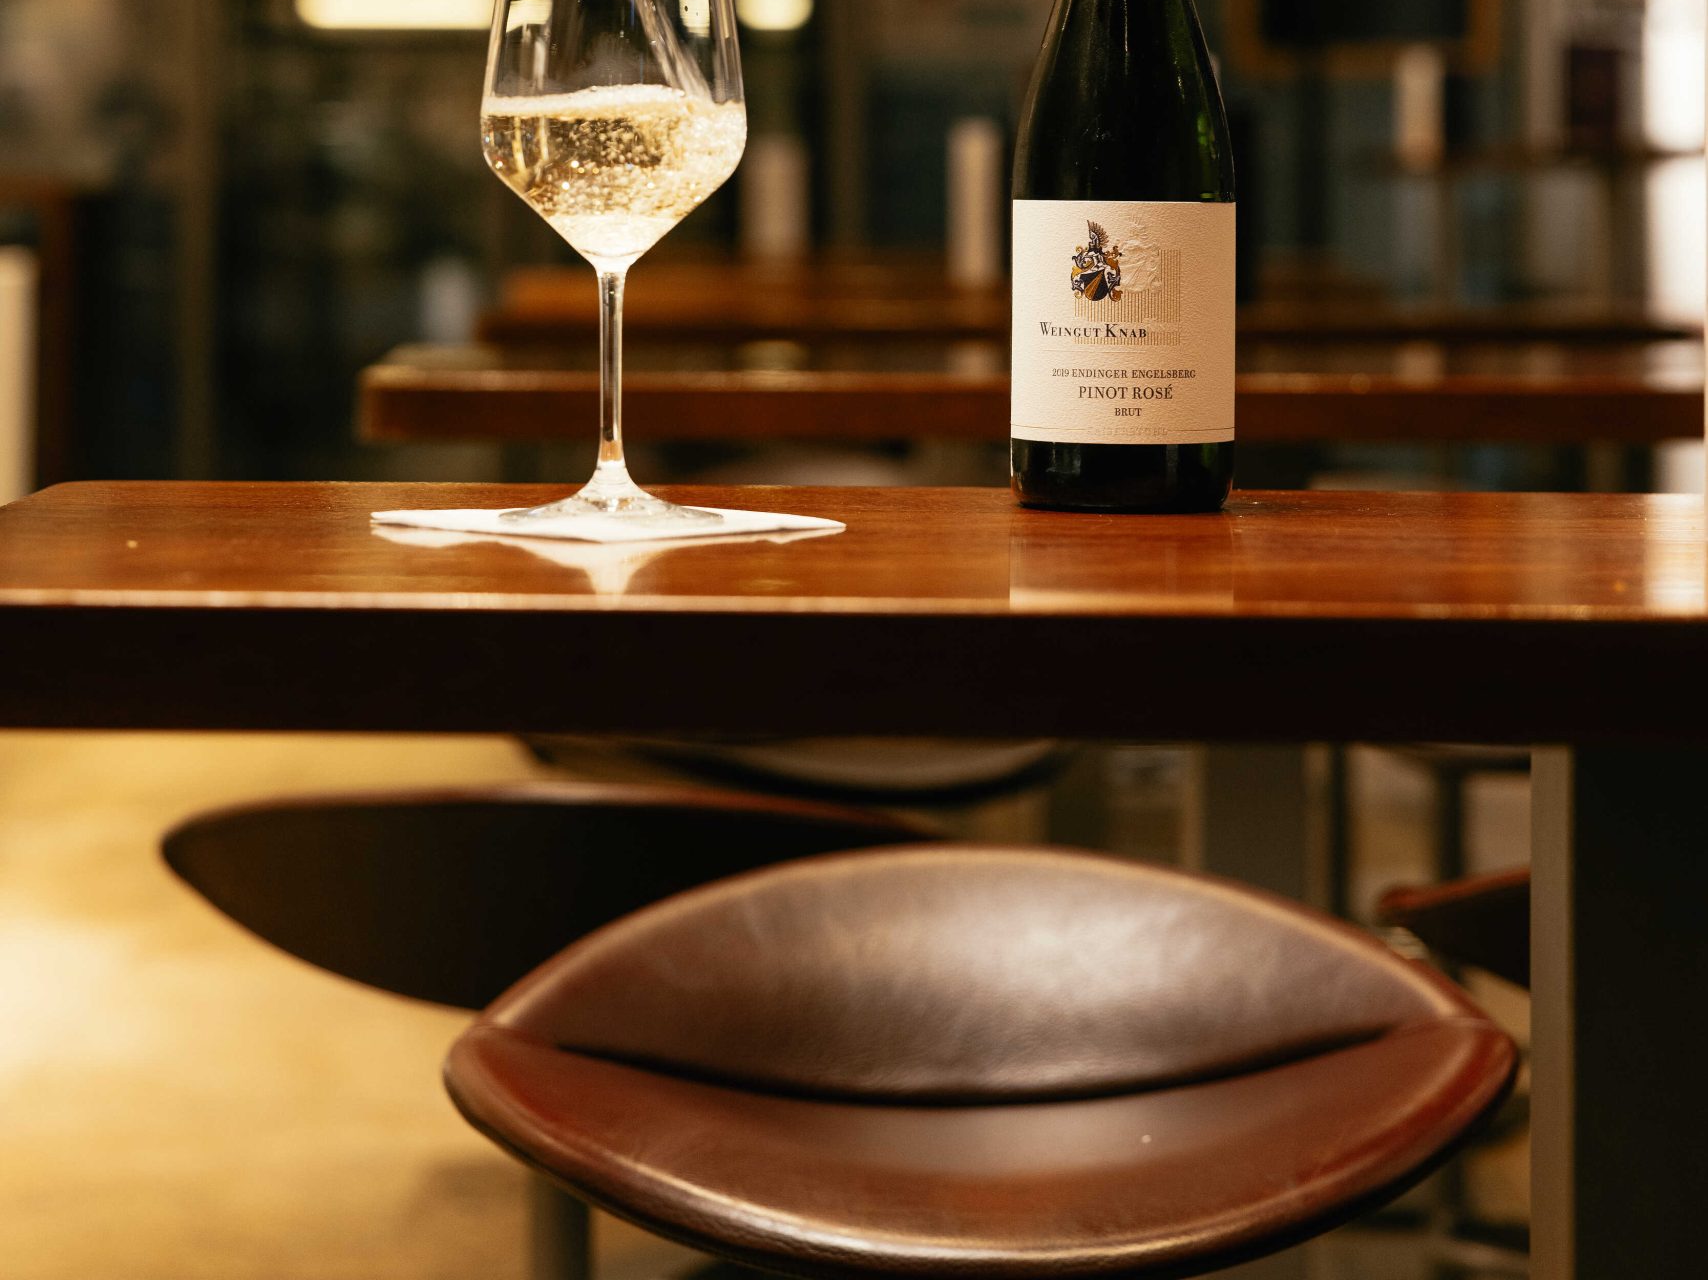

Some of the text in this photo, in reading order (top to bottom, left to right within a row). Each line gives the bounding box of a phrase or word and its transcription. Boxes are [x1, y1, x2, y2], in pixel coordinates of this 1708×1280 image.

[1051, 368, 1196, 379] 2019 ENDINGER ENGELSBERG
[1078, 383, 1173, 400] PINOT ROSÉ
[1114, 407, 1142, 417] BRUT
